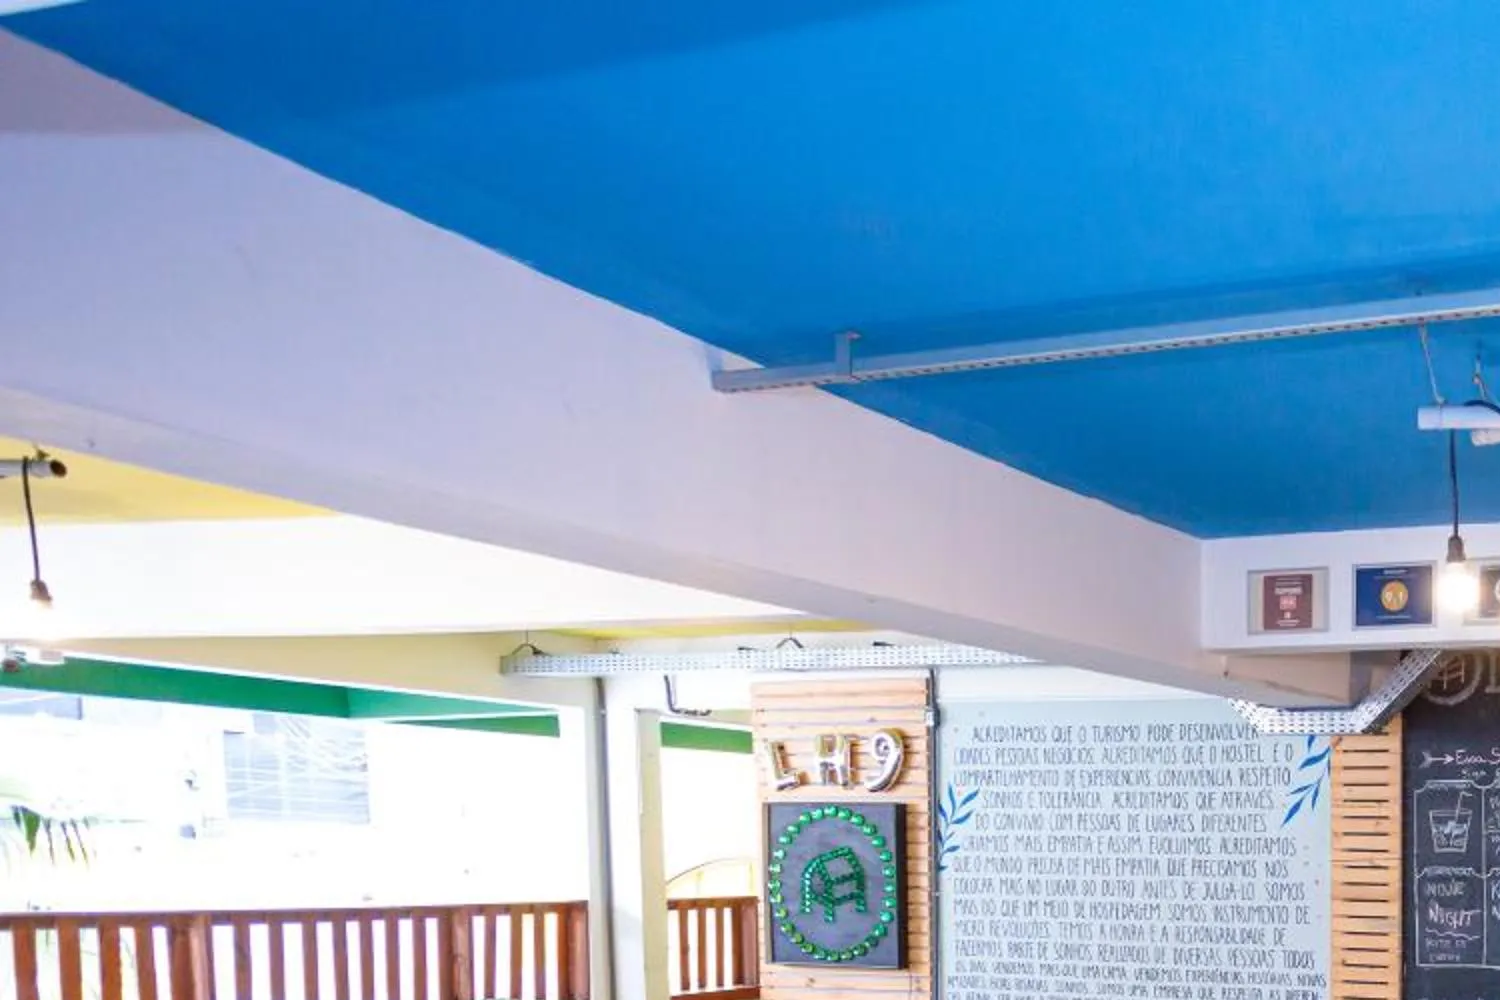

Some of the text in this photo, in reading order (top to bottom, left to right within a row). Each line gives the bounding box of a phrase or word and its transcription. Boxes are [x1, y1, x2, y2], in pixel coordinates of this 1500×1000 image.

[972, 725, 1047, 743] ACREDITAMOS
[1092, 723, 1140, 742] TURISMO
[1147, 723, 1174, 742] PODE
[1221, 744, 1265, 763] HOSTEL
[1077, 812, 1122, 831] PESSOAS
[1219, 837, 1298, 856] ACREDITAMOS
